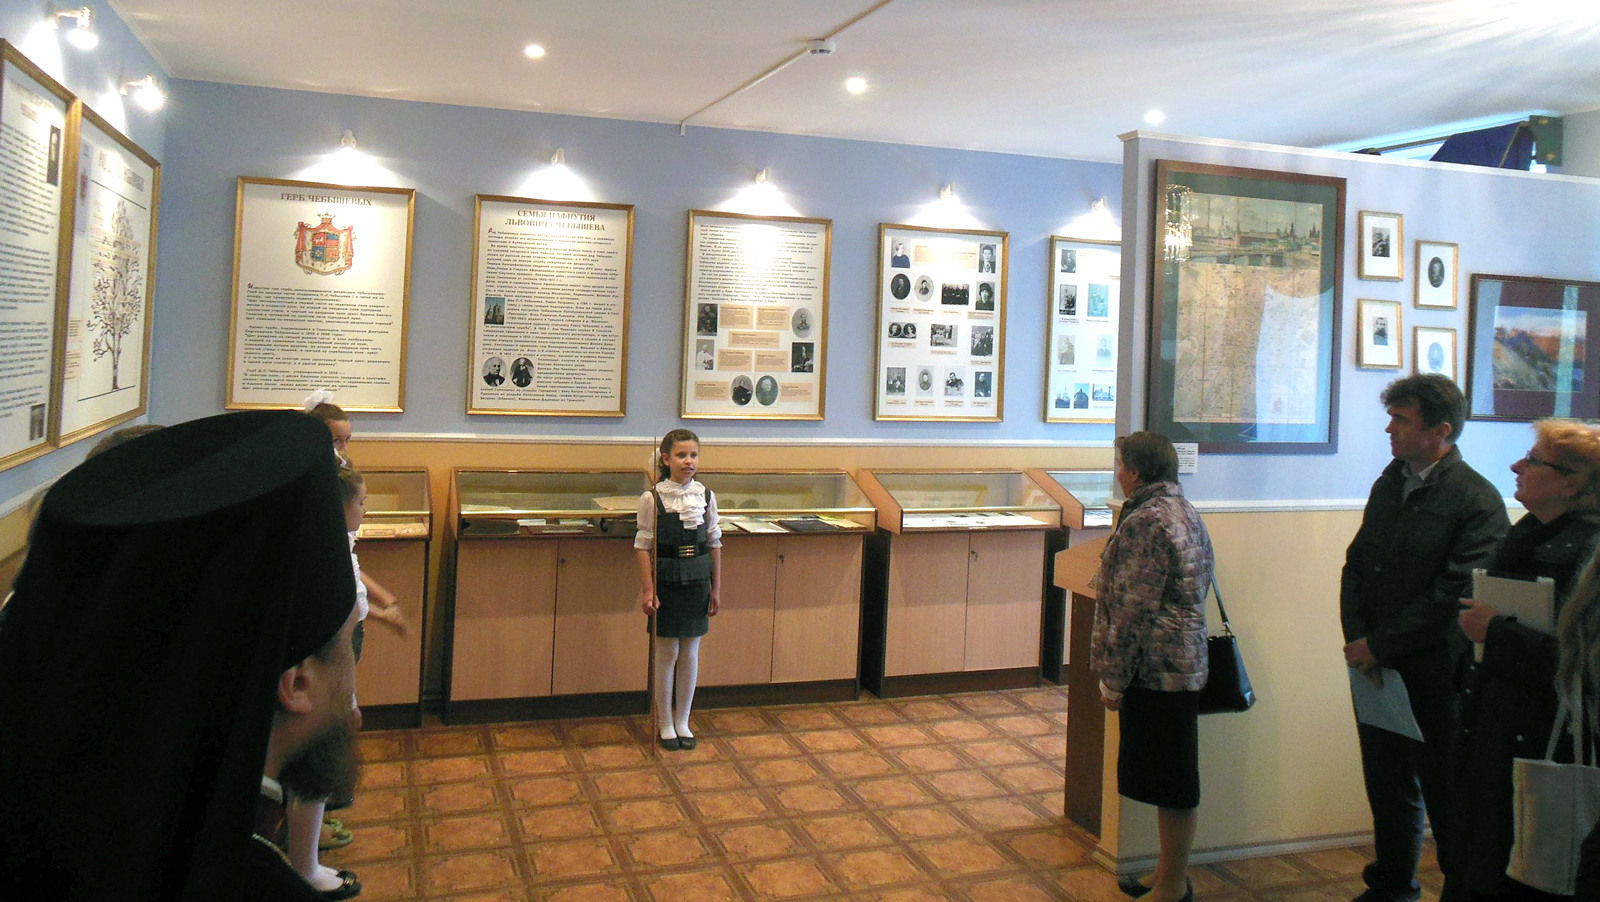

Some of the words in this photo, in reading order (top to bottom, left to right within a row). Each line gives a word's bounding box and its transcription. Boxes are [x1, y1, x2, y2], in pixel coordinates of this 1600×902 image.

[281, 193, 305, 201] ГЕРБ
[308, 194, 372, 206] ЧЕБЫШЕВЫХ
[517, 209, 546, 217] СЕМЬЯ
